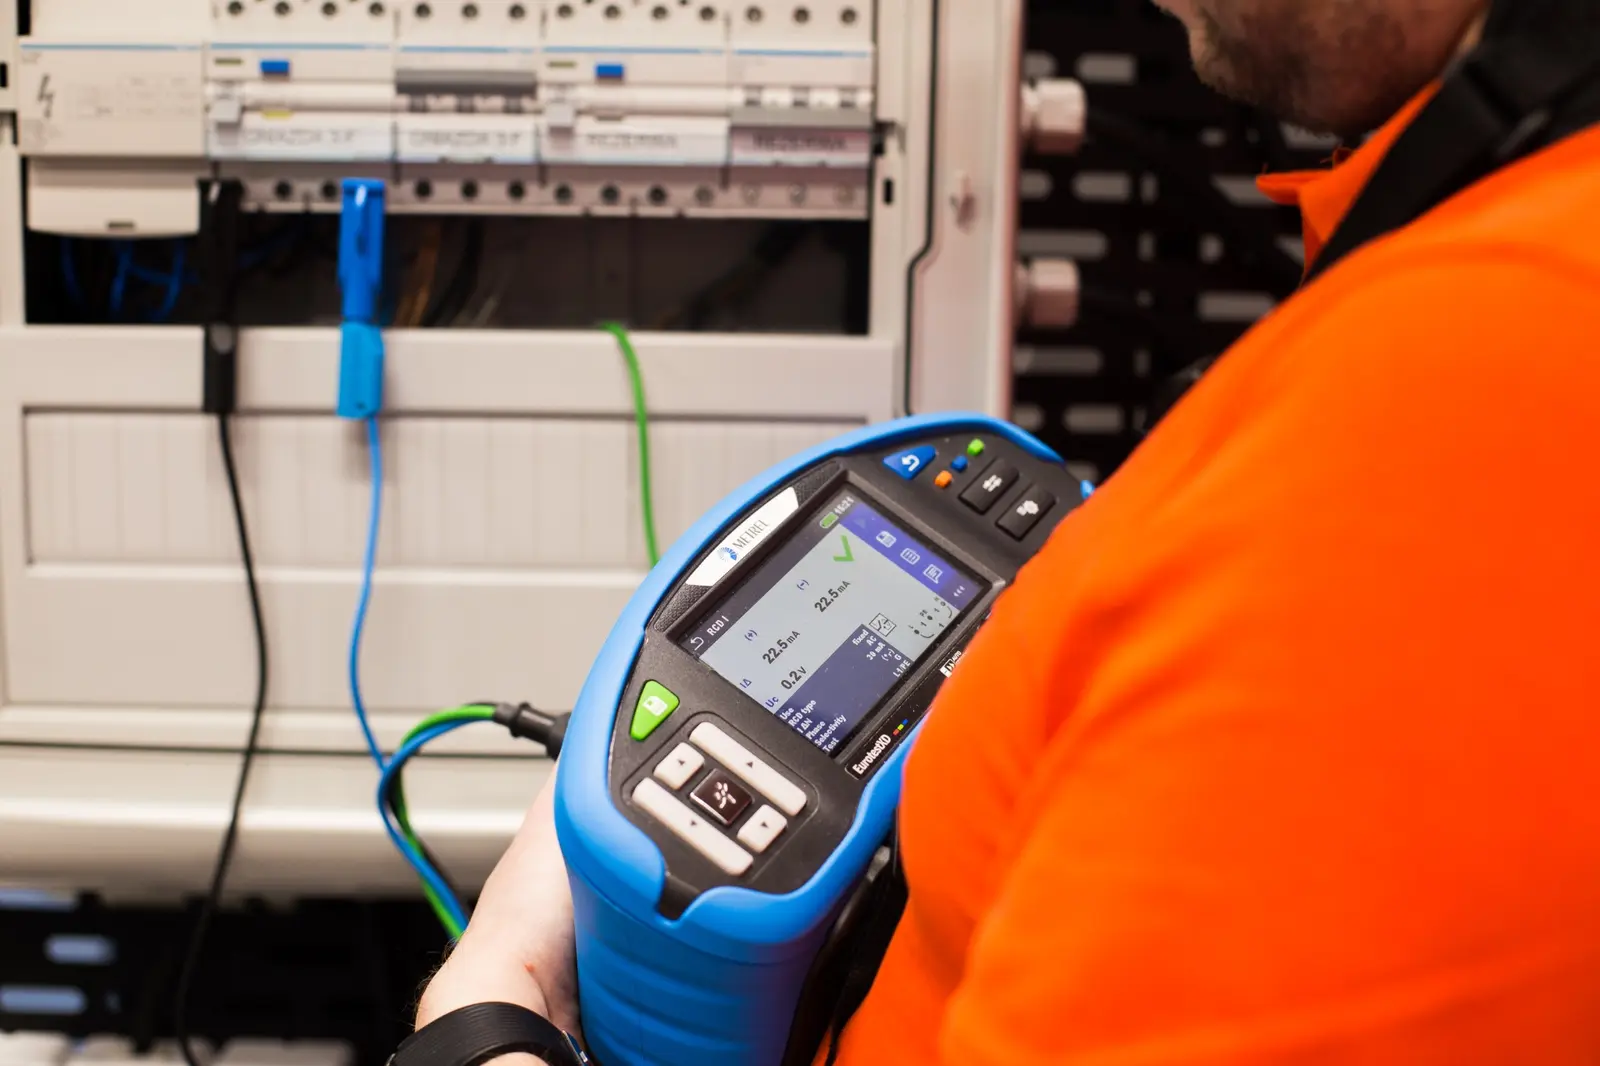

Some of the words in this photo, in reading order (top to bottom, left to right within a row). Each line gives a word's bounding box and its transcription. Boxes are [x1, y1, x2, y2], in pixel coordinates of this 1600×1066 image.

[732, 519, 769, 550] METREL
[706, 619, 725, 636] RCD
[780, 707, 795, 720] Use
[852, 628, 869, 646] fixed
[788, 712, 804, 727] RCD
[800, 699, 817, 714] type
[866, 635, 877, 646] AC
[805, 721, 826, 740] Phase
[814, 714, 847, 746] Selectivity
[822, 736, 840, 752] Test
[851, 733, 892, 775] EurotestXD
